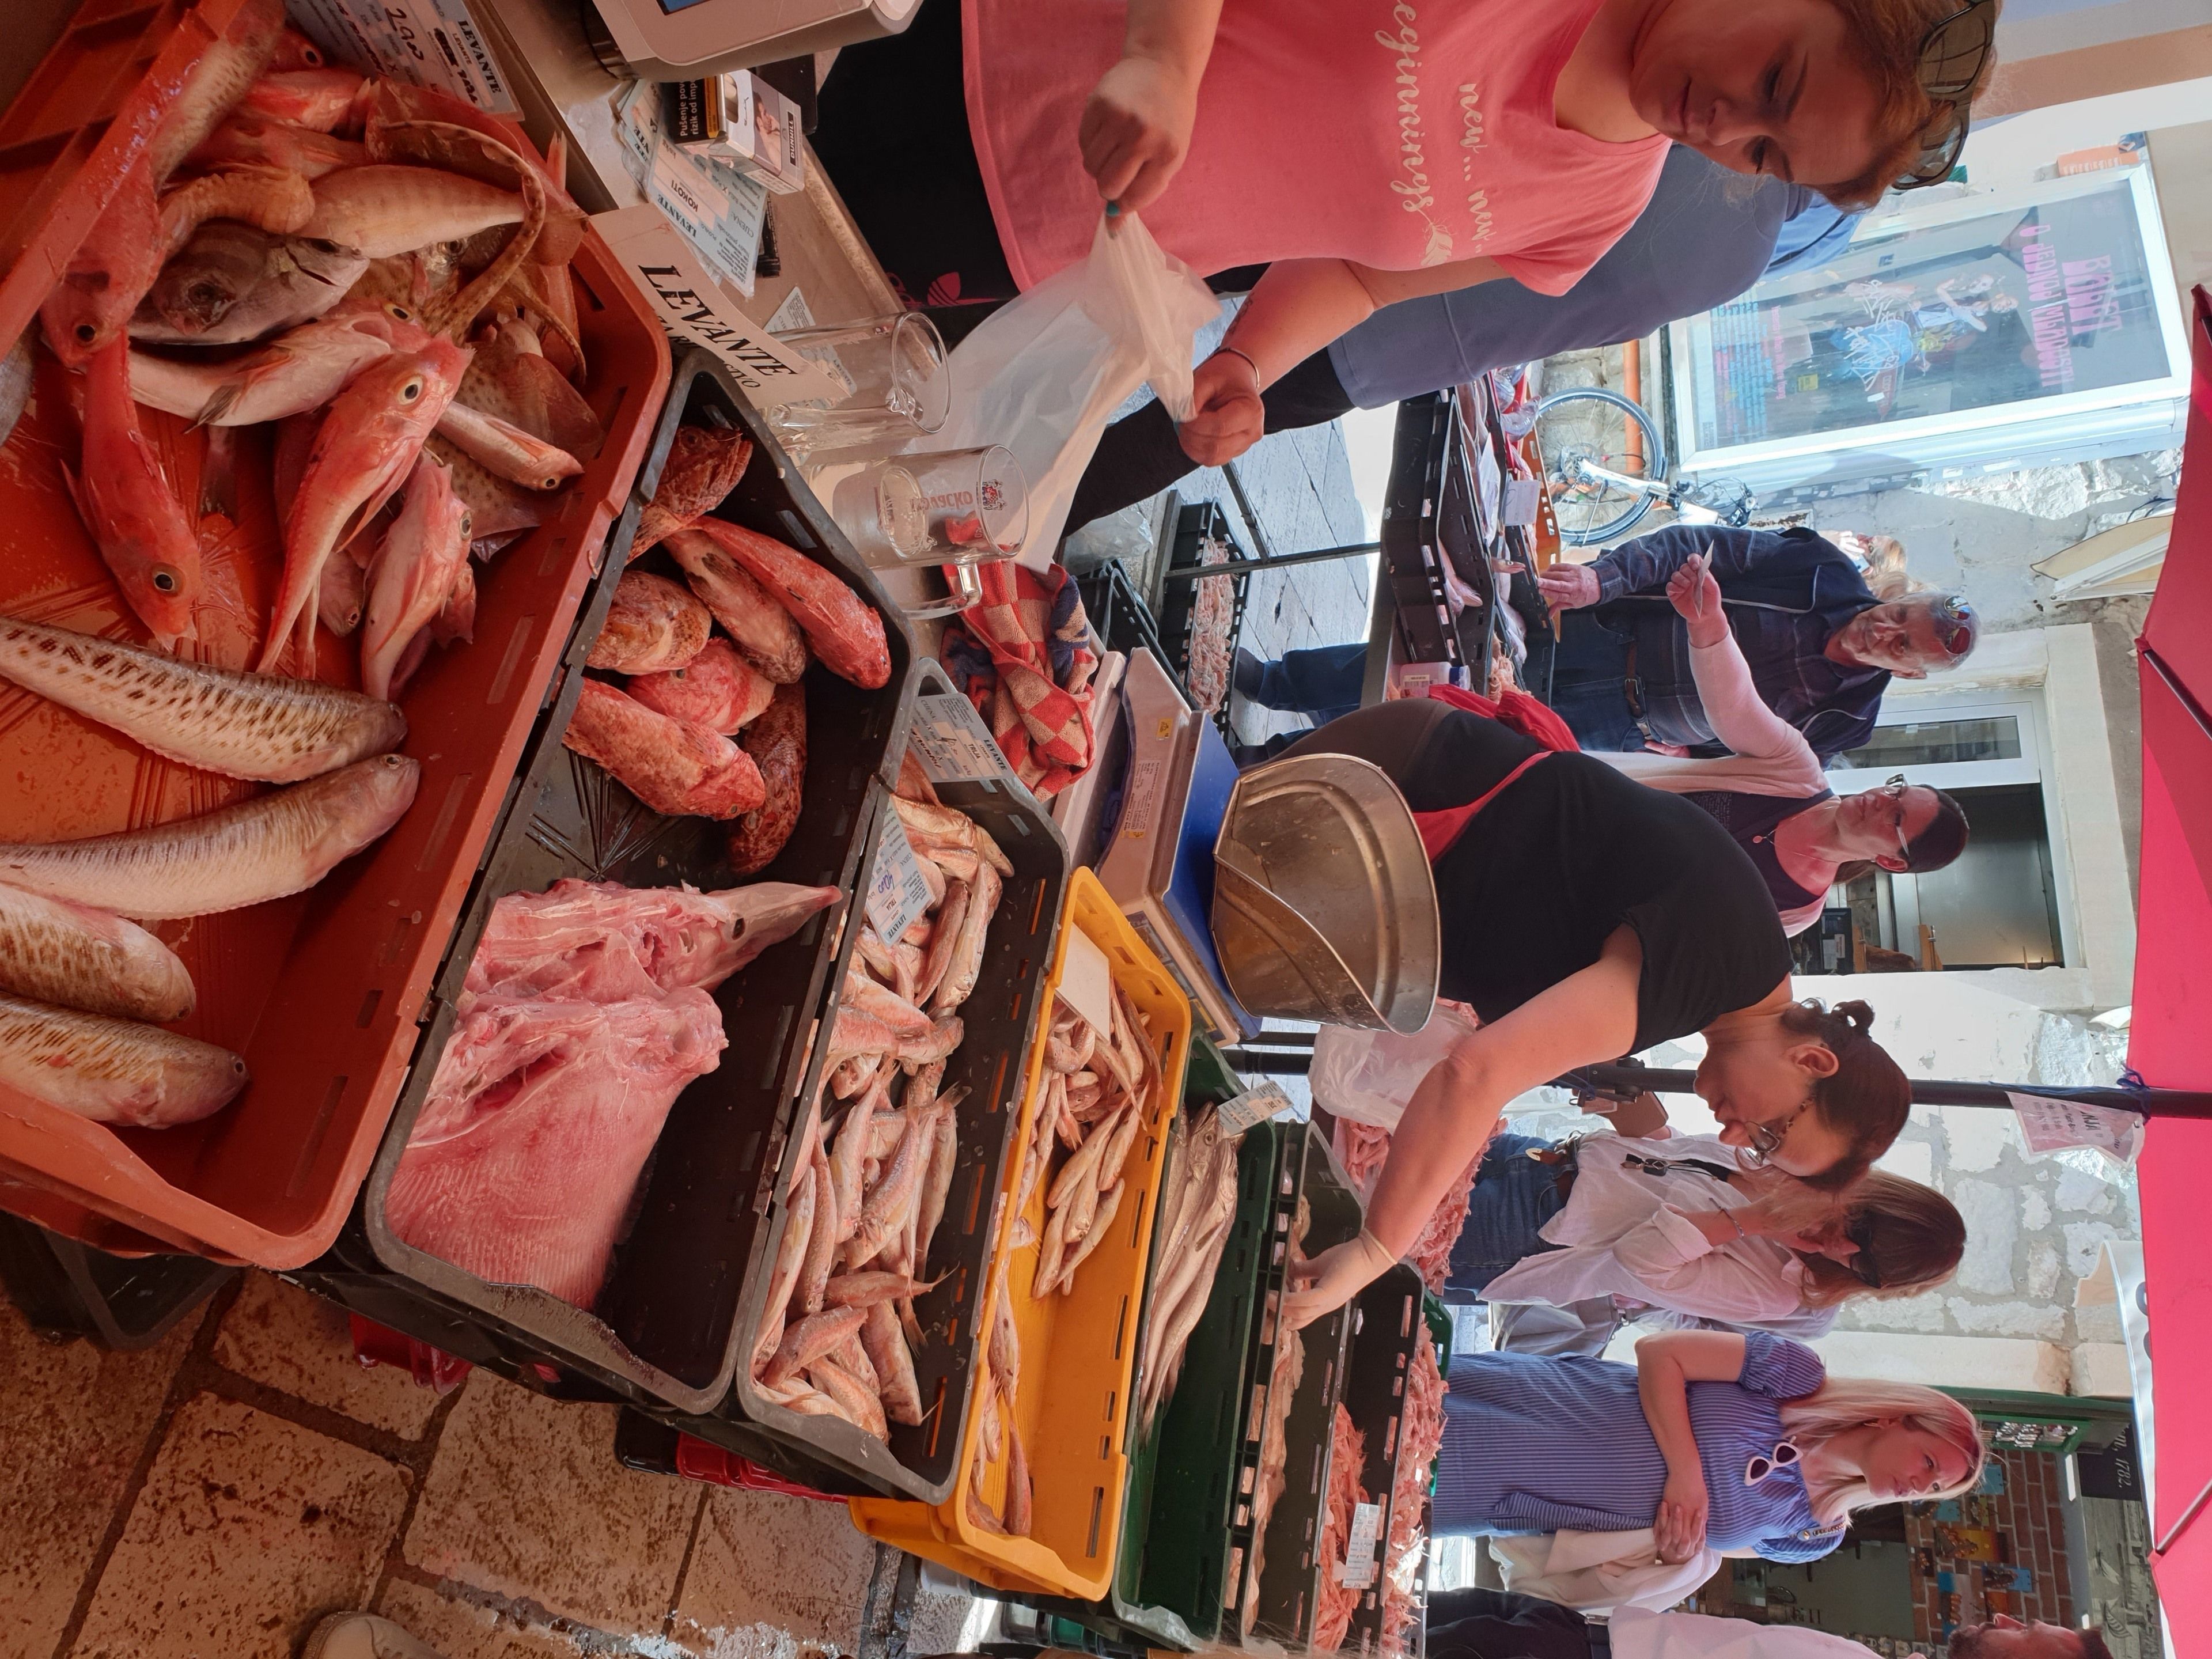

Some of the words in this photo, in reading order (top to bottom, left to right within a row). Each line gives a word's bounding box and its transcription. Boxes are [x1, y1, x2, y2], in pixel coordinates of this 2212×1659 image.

[452, 33, 472, 65] LEVANTE
[457, 20, 502, 94] LEVANTE
[679, 102, 688, 137] Pušenje
[688, 102, 698, 113] od
[1374, 0, 1434, 212] eginnings
[690, 116, 699, 135] rizik
[671, 179, 699, 213] KOKOTI
[657, 194, 697, 238] LEVANTE
[2019, 224, 2051, 237] O
[2022, 243, 2062, 301] JEDNOJ
[2062, 255, 2122, 335] BALET
[638, 265, 798, 376] LEVANTE
[2031, 305, 2074, 388] MLADOSTI
[968, 743, 981, 759] TRLJA
[983, 739, 1007, 770] LEVANTE
[887, 914, 907, 939] LEVANTE
[2115, 1458, 2133, 1489] 1782.
